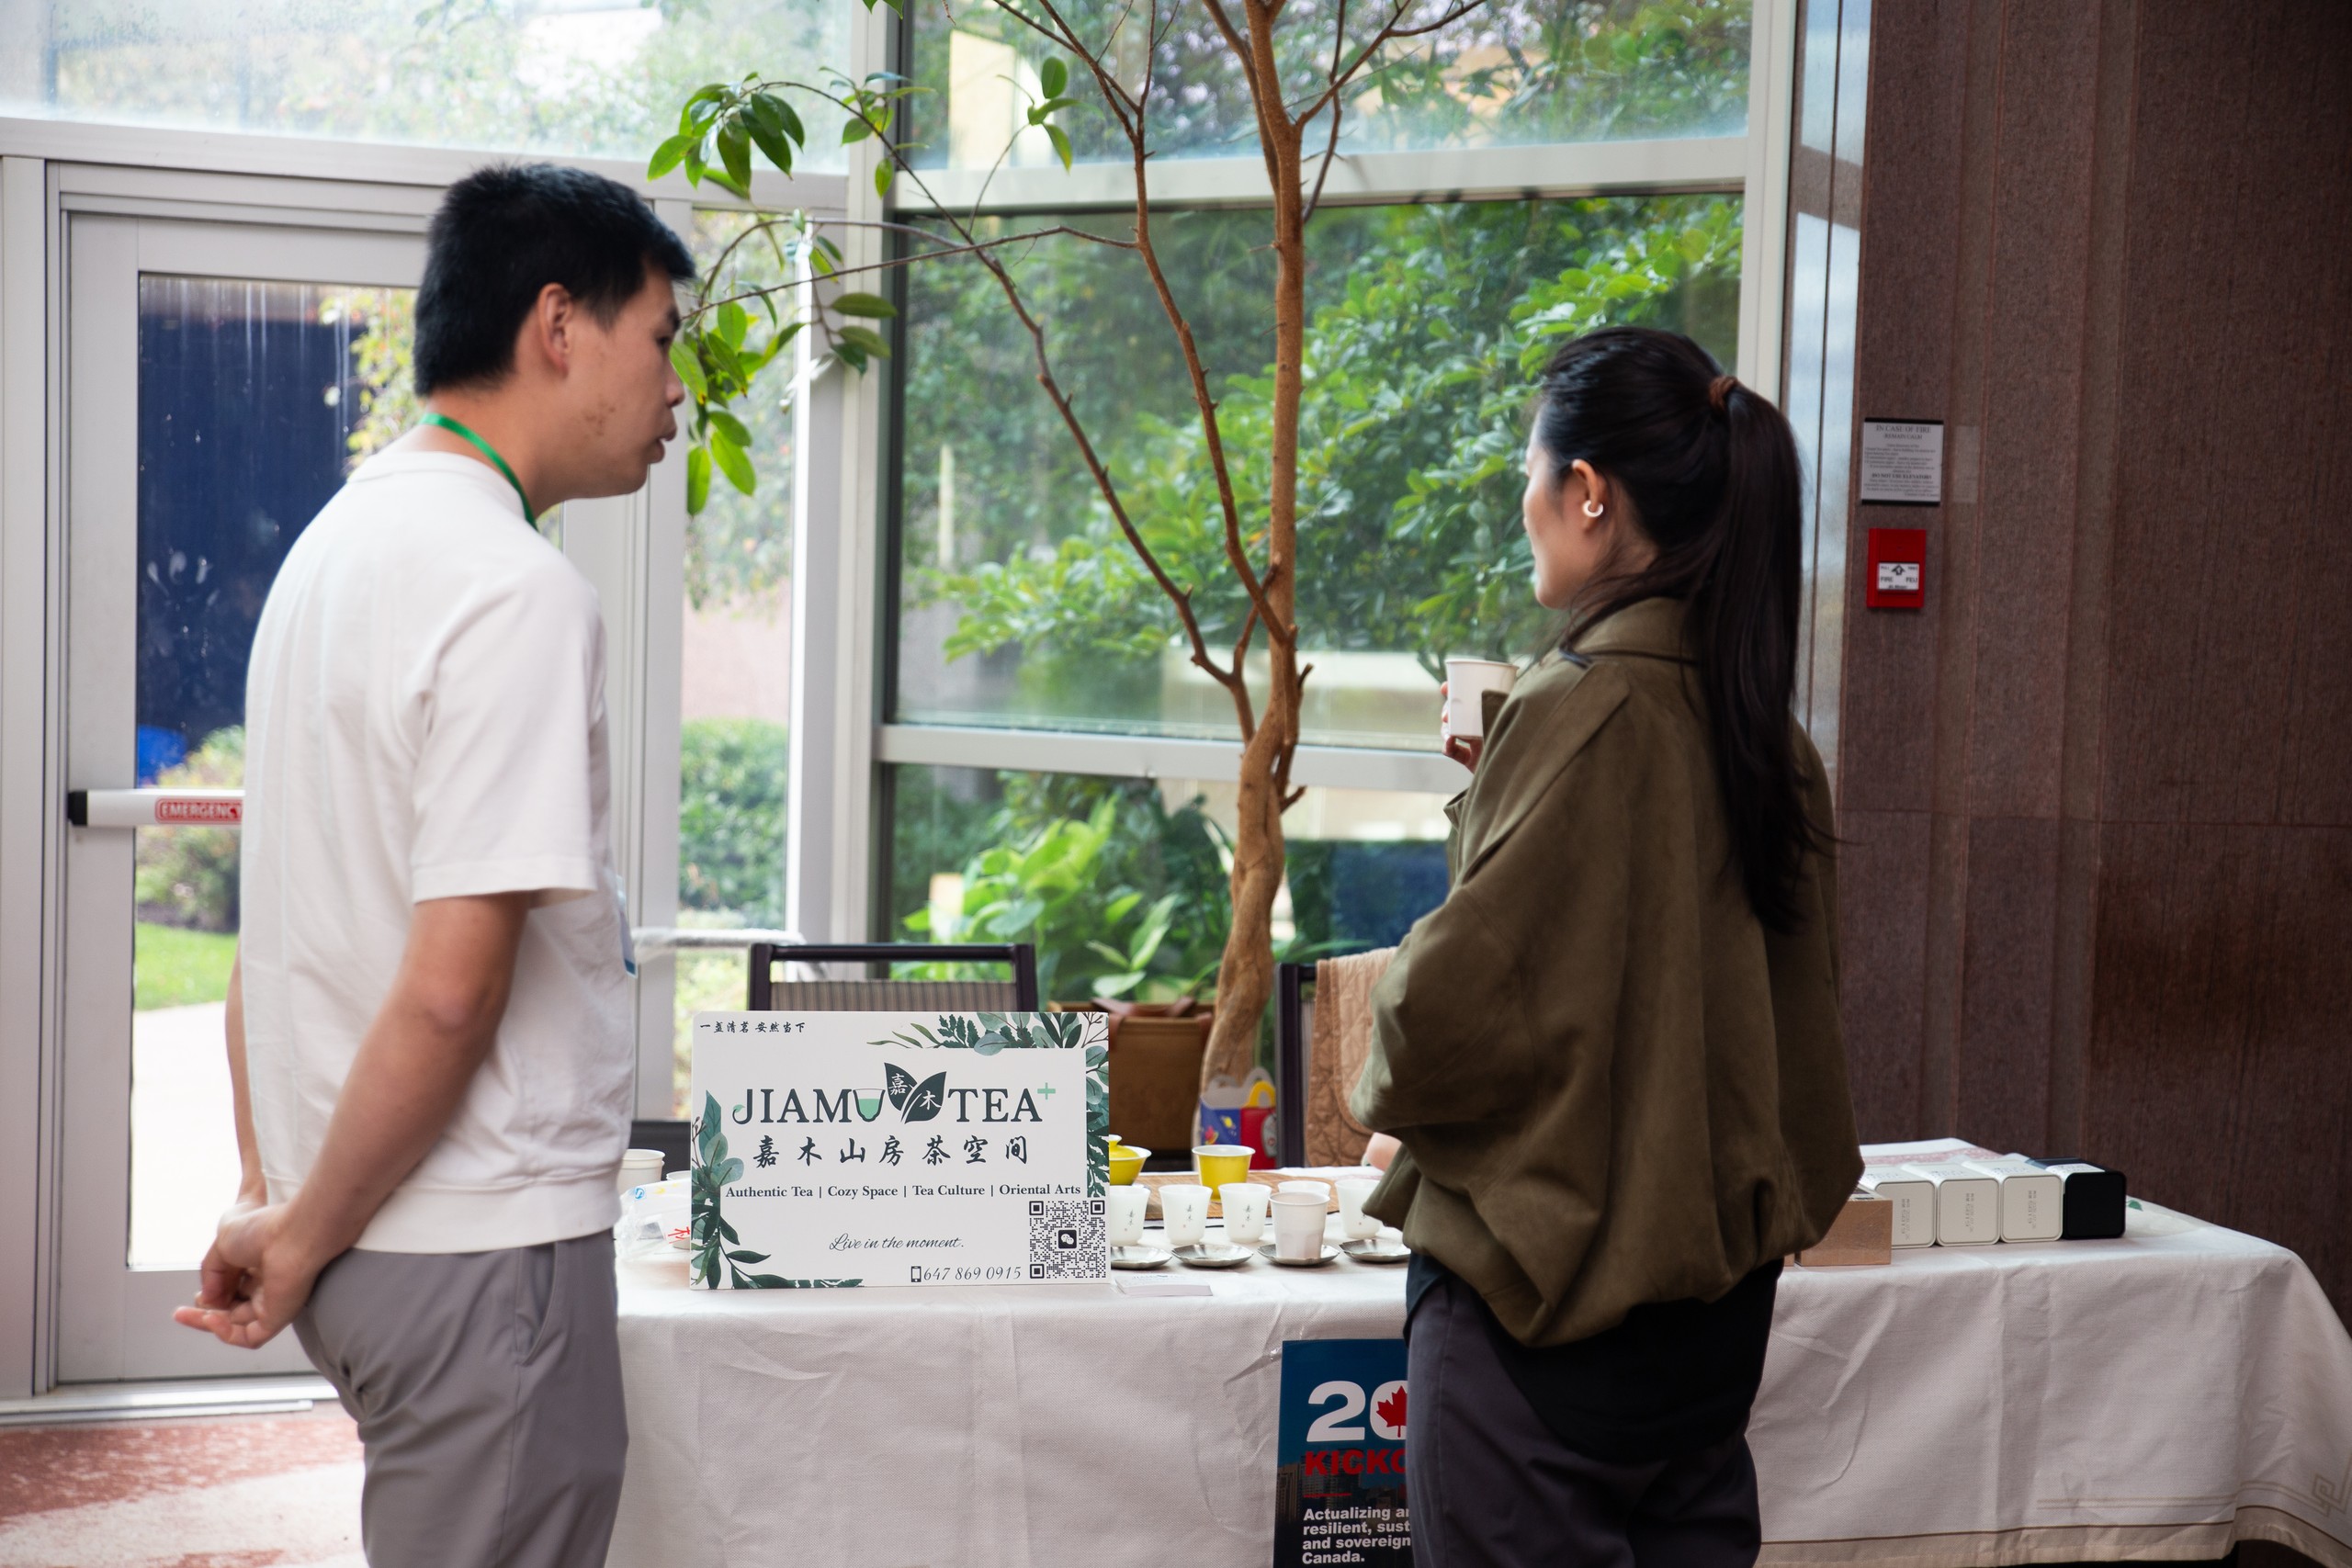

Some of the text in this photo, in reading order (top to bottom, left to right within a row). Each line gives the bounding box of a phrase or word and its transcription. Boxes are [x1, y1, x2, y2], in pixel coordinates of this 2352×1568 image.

[753, 1134, 1028, 1168] 嘉木山房茶空间
[726, 1183, 1081, 1200] Authentic Tea Cozy Space Tea Culture Oriental Arts
[829, 1233, 965, 1251] Live in the moment.
[923, 1266, 1022, 1281] 647 869 0915
[1303, 1506, 1391, 1521] Actualizing
[1303, 1520, 1410, 1536] resilient, sust
[1303, 1535, 1411, 1550] and sovereign
[1302, 1551, 1365, 1564] Canada.
